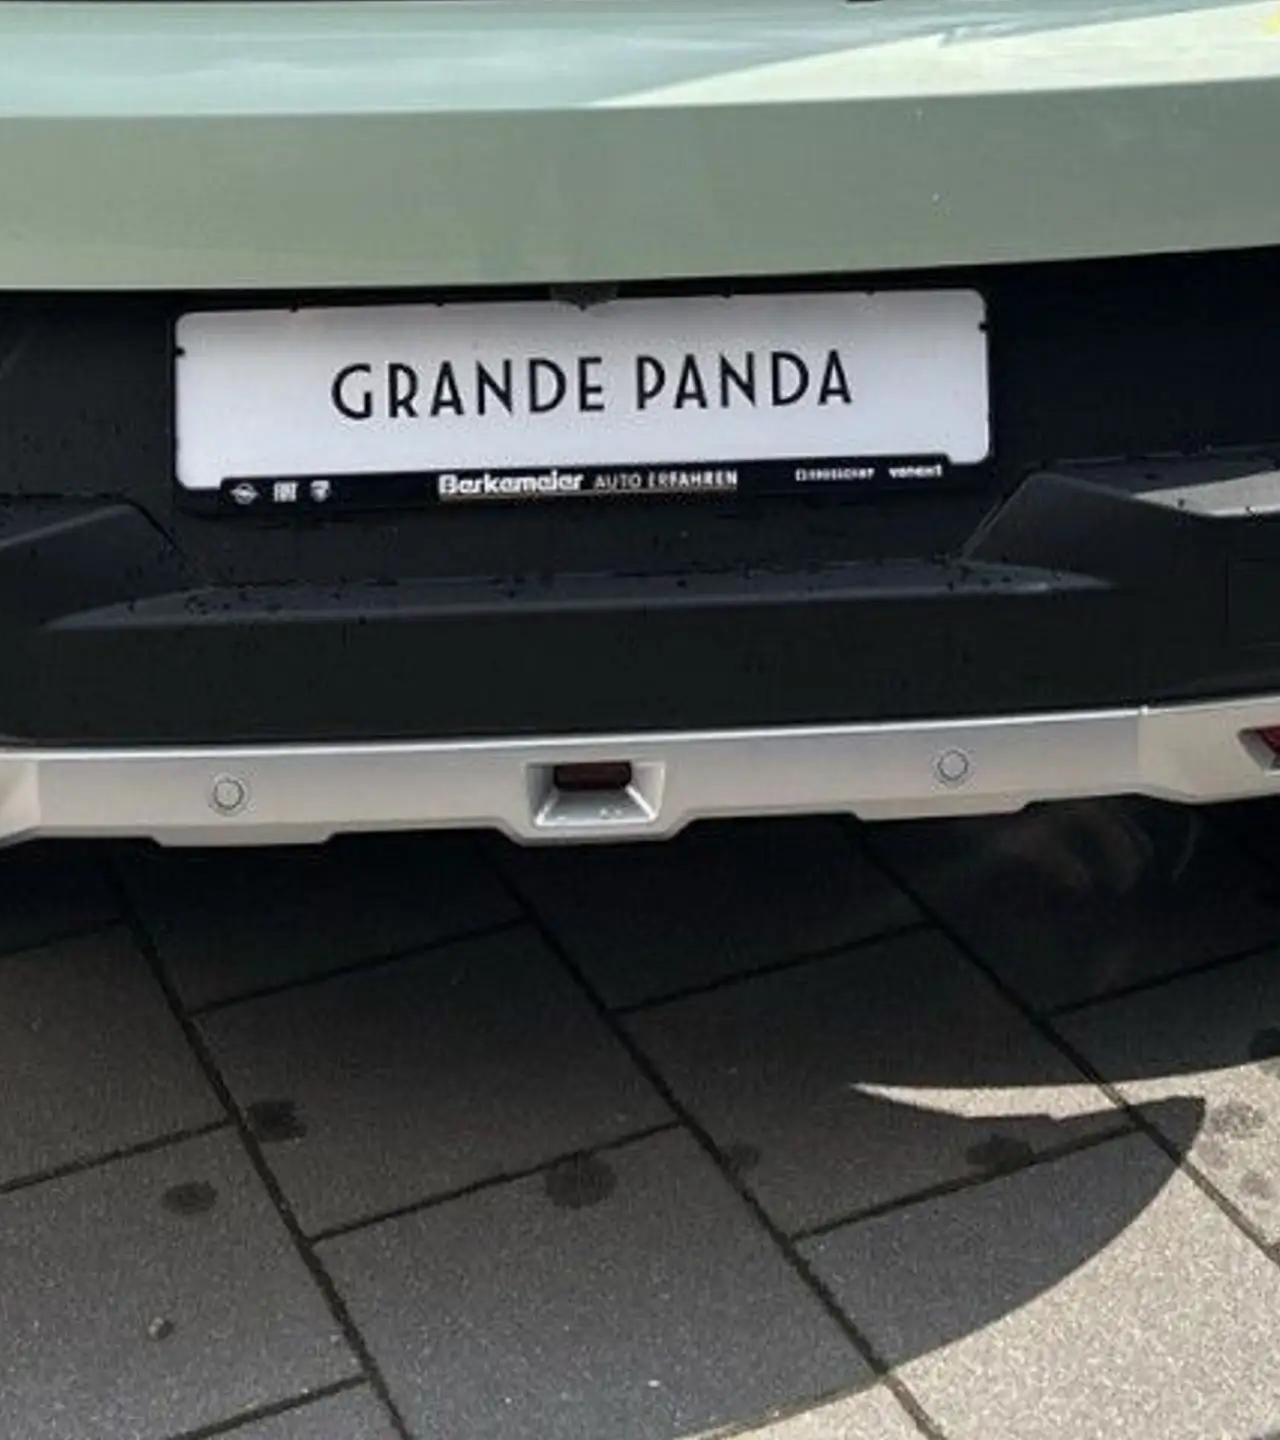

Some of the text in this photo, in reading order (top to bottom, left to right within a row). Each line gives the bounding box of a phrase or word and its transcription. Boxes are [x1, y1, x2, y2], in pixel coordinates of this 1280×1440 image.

[330, 348, 853, 420] GRANDE PANDA
[594, 472, 642, 490] AUTO
[647, 469, 738, 490] ERFAHREN
